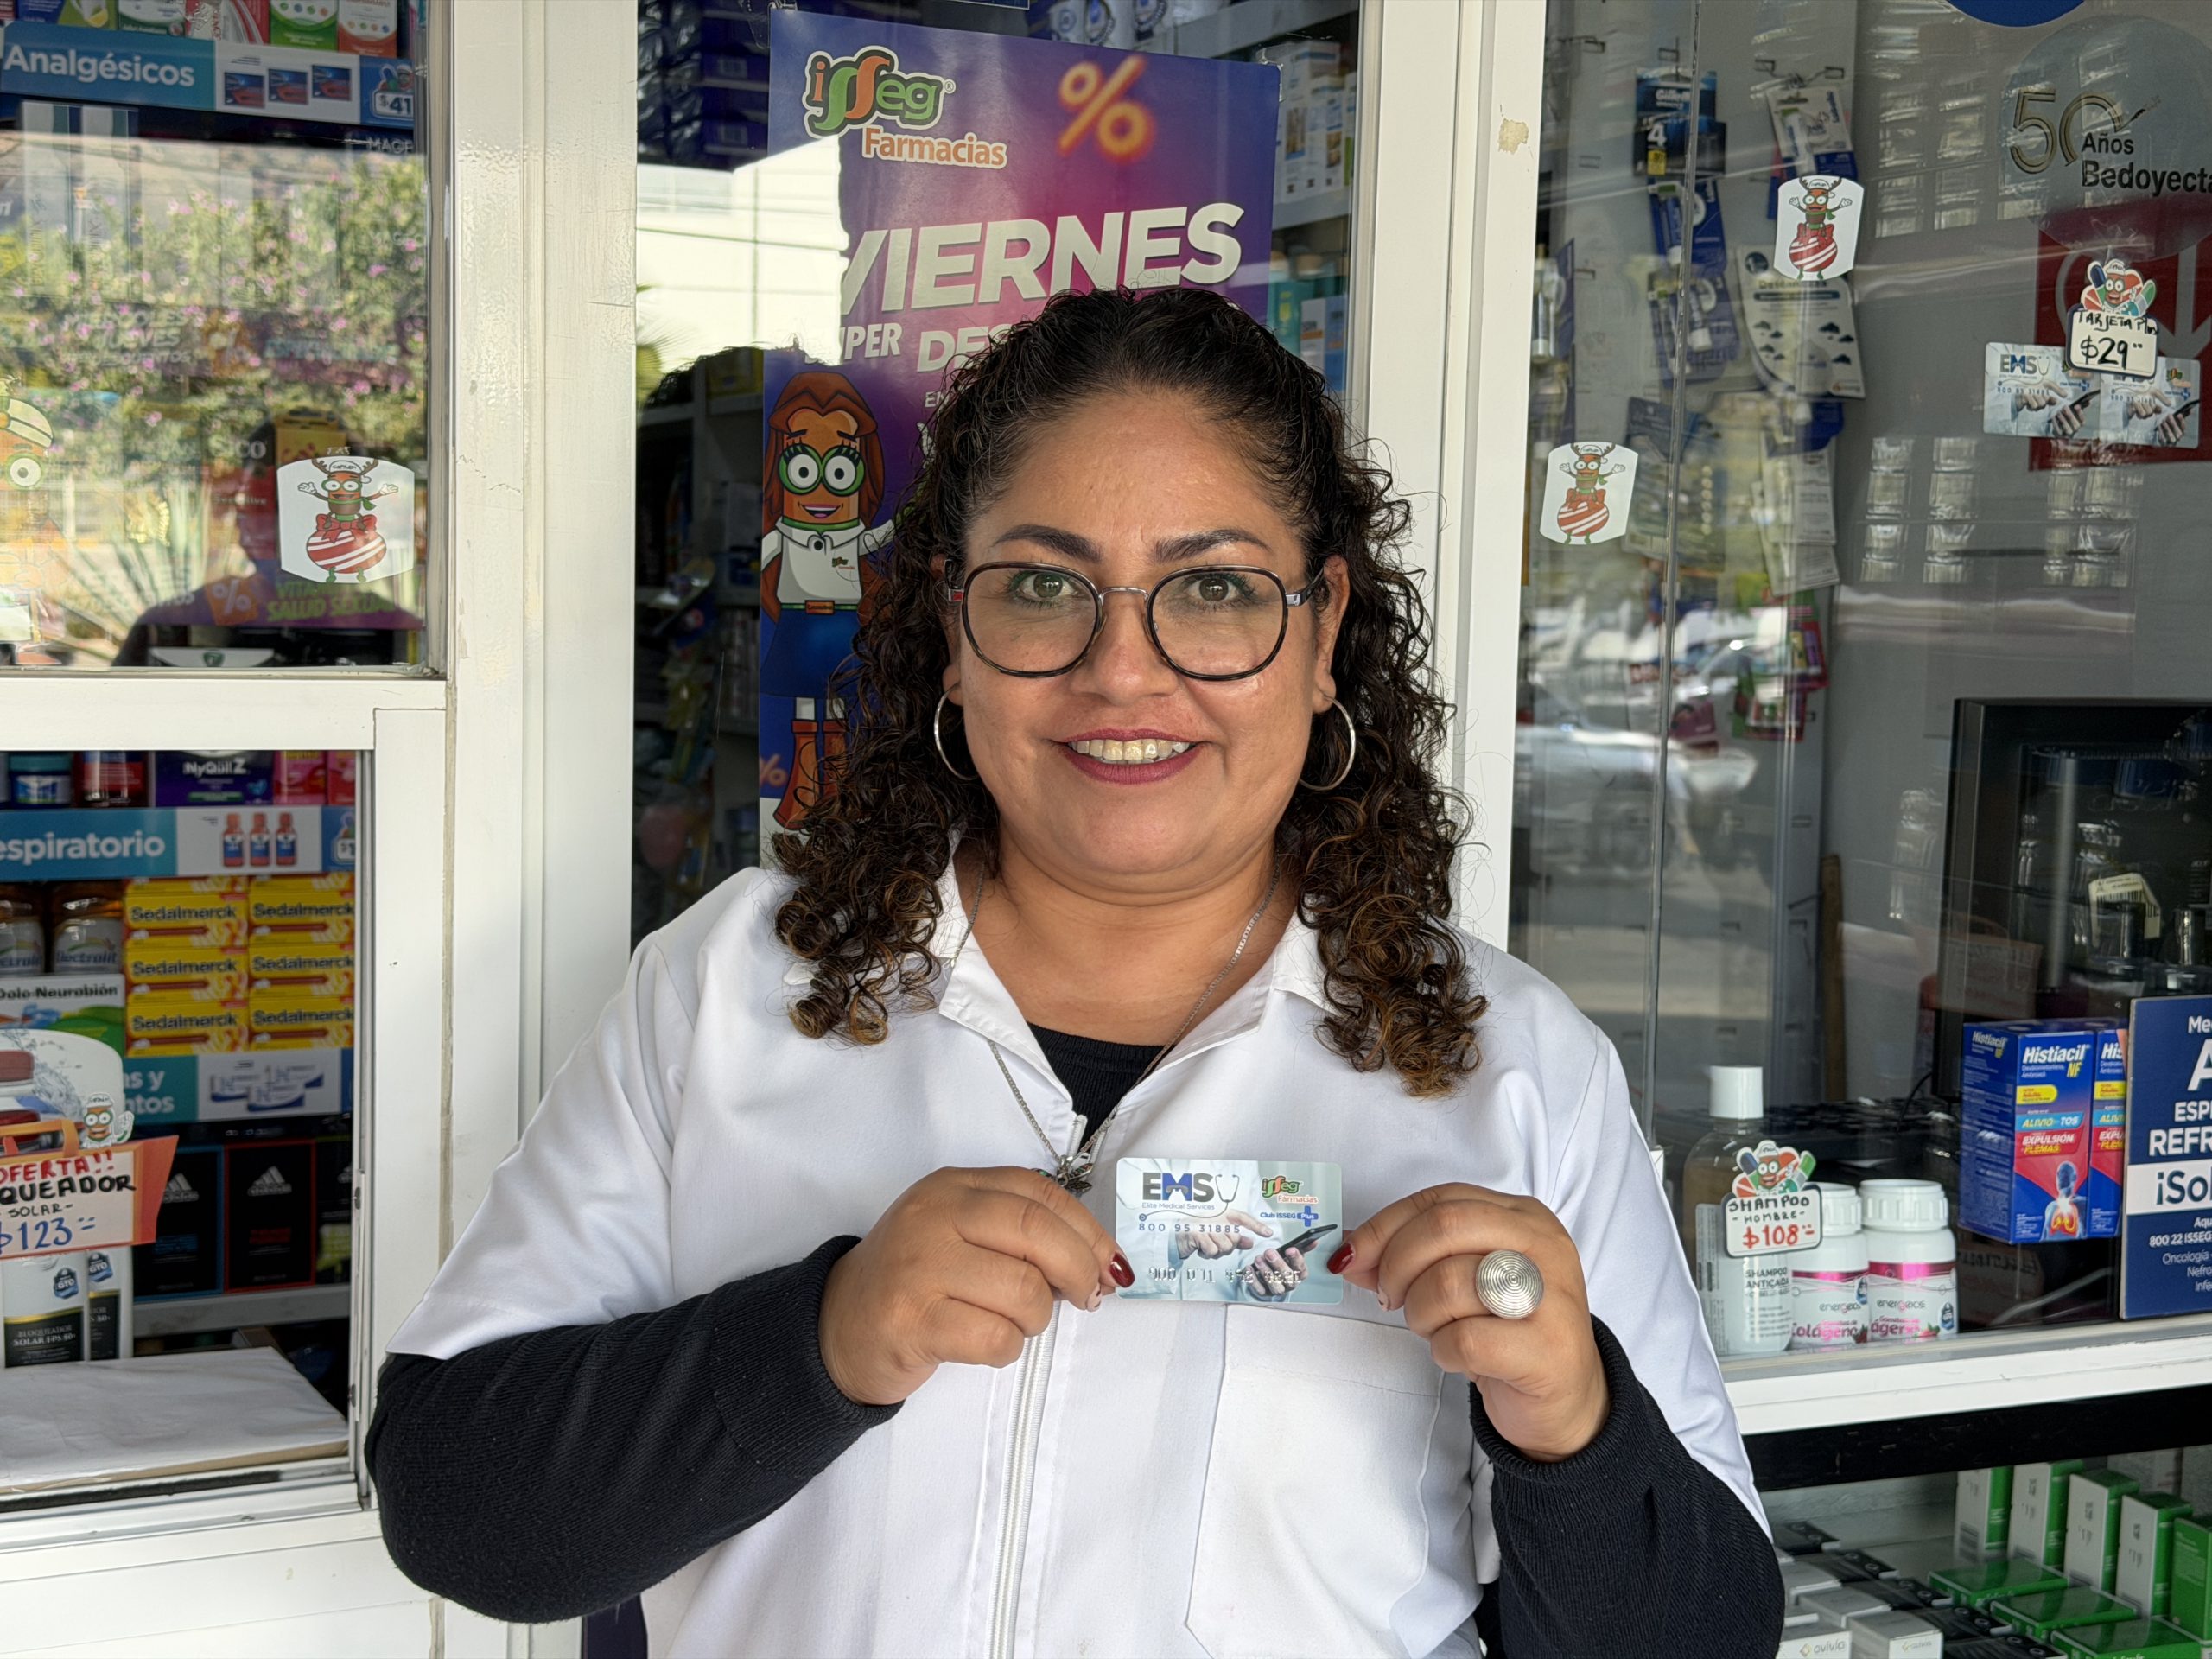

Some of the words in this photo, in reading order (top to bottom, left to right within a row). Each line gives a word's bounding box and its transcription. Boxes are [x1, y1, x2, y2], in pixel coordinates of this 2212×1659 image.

[4, 44, 195, 87] Analgésicos
[864, 128, 1005, 167] Farmacias
[2081, 132, 2134, 155] Años
[2078, 311, 2133, 332] TARJETA
[838, 322, 903, 361] PER
[1999, 353, 2037, 375] EMS
[131, 905, 238, 921] Sedalmerck
[132, 957, 238, 976] Sedalmerck
[132, 1013, 238, 1031] Sedalmerck
[2022, 1044, 2087, 1064] Histiacil
[2066, 1062, 2083, 1078] NF
[148, 1070, 165, 1091] y
[2022, 1131, 2075, 1146] EXPULSIÓN
[1142, 1172, 1215, 1203] EMS
[1278, 1194, 1319, 1204] Farmacias
[1728, 1194, 1810, 1212] SHAMPOO
[1139, 1223, 1166, 1231] 800
[1174, 1224, 1191, 1232] 95
[1198, 1224, 1241, 1234] 31885
[2149, 1234, 2170, 1248] 800
[2171, 1233, 2183, 1245] 22
[2162, 1249, 2209, 1265] Oncología
